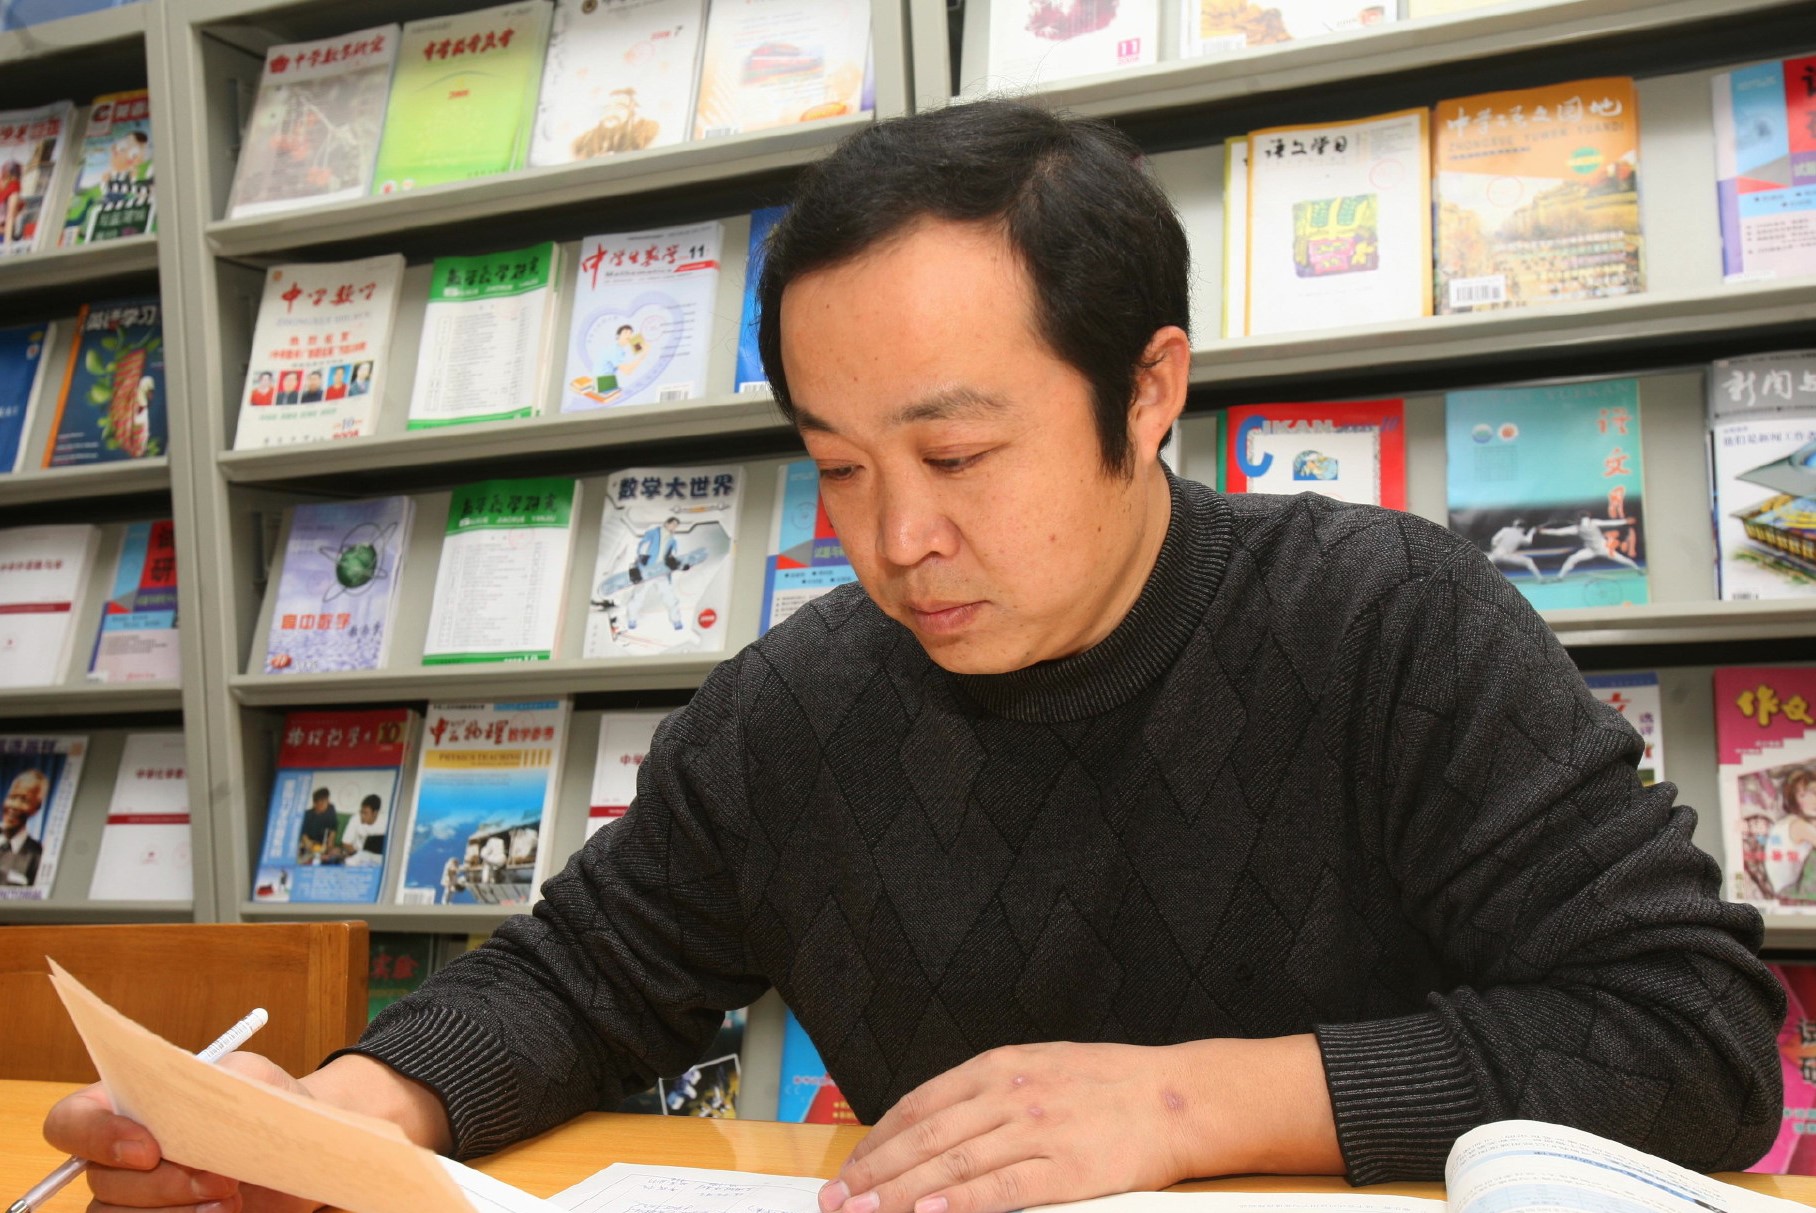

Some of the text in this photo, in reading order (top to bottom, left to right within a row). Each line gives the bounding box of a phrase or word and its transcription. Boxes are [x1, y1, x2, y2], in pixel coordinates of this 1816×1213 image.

[690, 244, 705, 259] 11
[618, 473, 734, 500] 数学大世界
[281, 612, 352, 630] 高中数学
